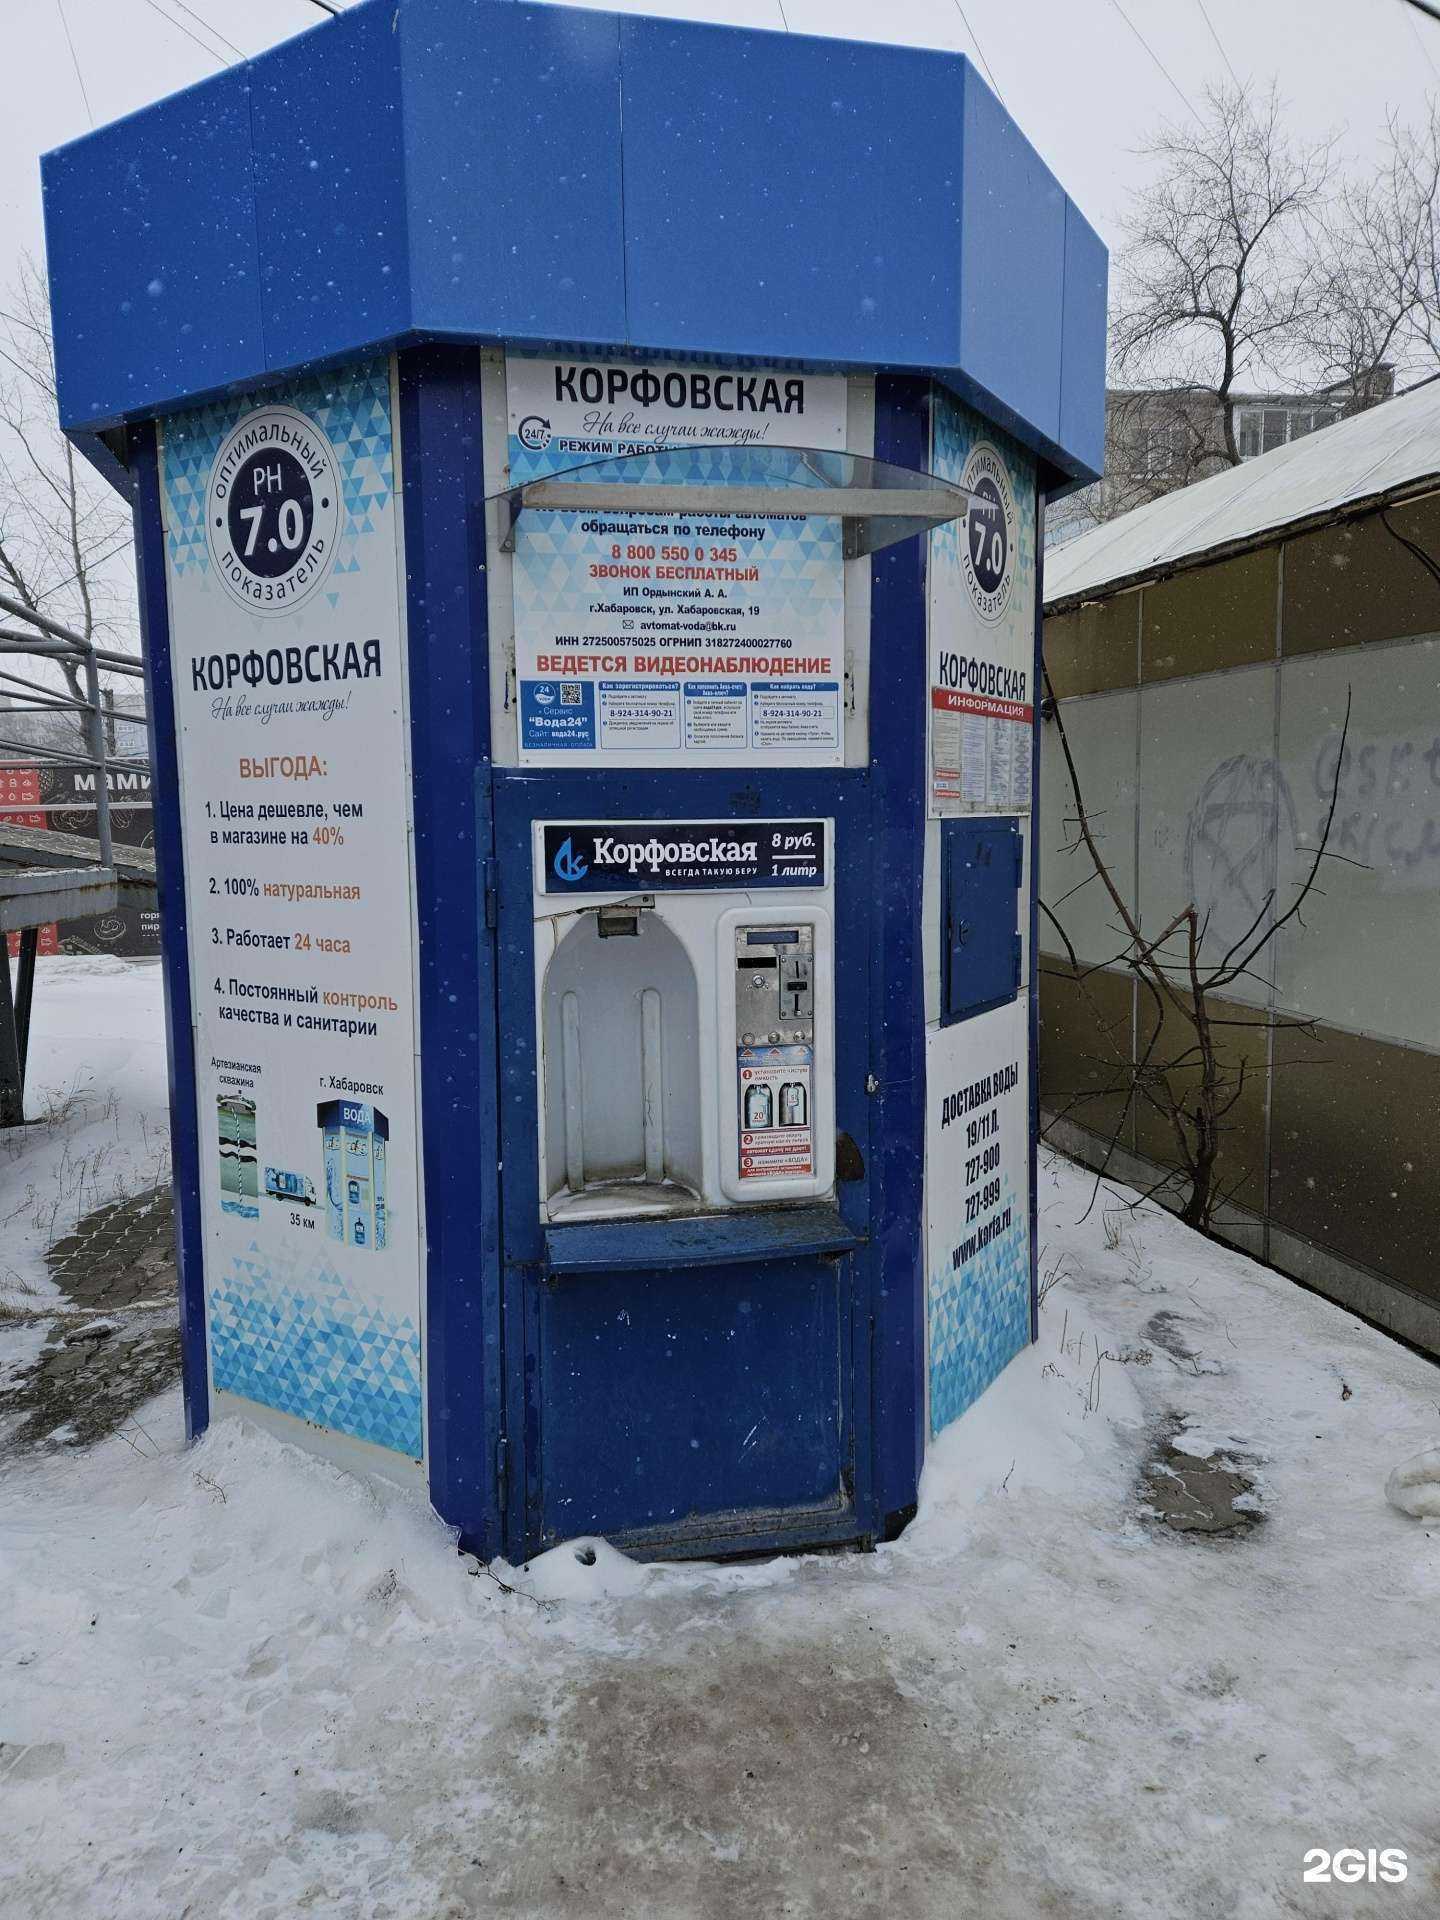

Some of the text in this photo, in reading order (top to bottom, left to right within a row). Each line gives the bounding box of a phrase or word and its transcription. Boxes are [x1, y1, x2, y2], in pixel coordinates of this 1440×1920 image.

[555, 366, 804, 414] КОРФОВСКАЯ
[524, 428, 544, 440] 24/7
[583, 411, 770, 446] На все случаи жажды!
[559, 439, 613, 454] РЕЖИМ
[967, 457, 1014, 525] птимальный
[239, 499, 304, 556] 7.0
[581, 519, 766, 540] обращаться по телефону
[611, 544, 738, 562] 8 800 550 0 345
[974, 521, 1002, 575] 7.0
[589, 564, 759, 582] ЗВОНОК БЕСПЛАТНЫЙ
[623, 587, 728, 599] ИП Ордынский А. А.
[658, 605, 674, 616] ул.
[677, 604, 745, 617] Хабаровская,
[748, 605, 760, 615] 19
[640, 620, 737, 632] avtomat-voda@bk.ru
[555, 636, 792, 649] ИНН 272500575025 ОГРНИП 318272400027760
[191, 639, 382, 691] КОРФОВСКАЯ
[537, 655, 832, 676] ВЕДЕТСЯ ВИДЕОНАБЛЮДЕНИЕ
[939, 651, 1026, 702] КОРФОВСКАЯ
[539, 685, 549, 693] 24
[211, 690, 352, 725] На все случаи жажды!
[543, 707, 573, 715] Сервис
[610, 709, 672, 717] 8-924-314-90-21
[948, 694, 1024, 717] ИНФОРМАЦИЯ
[239, 755, 329, 781] ВЫГОДА:
[205, 800, 363, 821] 1. Цена дешевле, чем
[210, 826, 344, 846] в магазине на 40%
[771, 833, 816, 851] 8 руб.
[592, 837, 758, 873] Корфовская
[665, 867, 758, 877] ВСЕГДА ТАКУЮ БЕРУ
[771, 865, 817, 878] 1 литр
[209, 877, 361, 901] 2. 100% натуральная
[211, 928, 351, 953] 3. Работает 24 часа
[214, 977, 398, 1012] 4. Постоянный контроль
[219, 1005, 378, 1037] качества и санитарии
[211, 1056, 262, 1074] Артезианская
[219, 1075, 254, 1088] скважина
[319, 1075, 384, 1095] г. Хабаровск
[942, 1061, 1019, 1129] ДОСТАВКА ВОДЫ
[343, 1107, 371, 1124] ВОДА
[753, 1112, 764, 1120] 20
[966, 1112, 990, 1149] 19/11
[965, 1142, 1000, 1187] 727-900
[965, 1177, 1000, 1224] 727-999
[290, 1213, 315, 1230] 35 км
[952, 1206, 1011, 1271] www.korfa.ru
